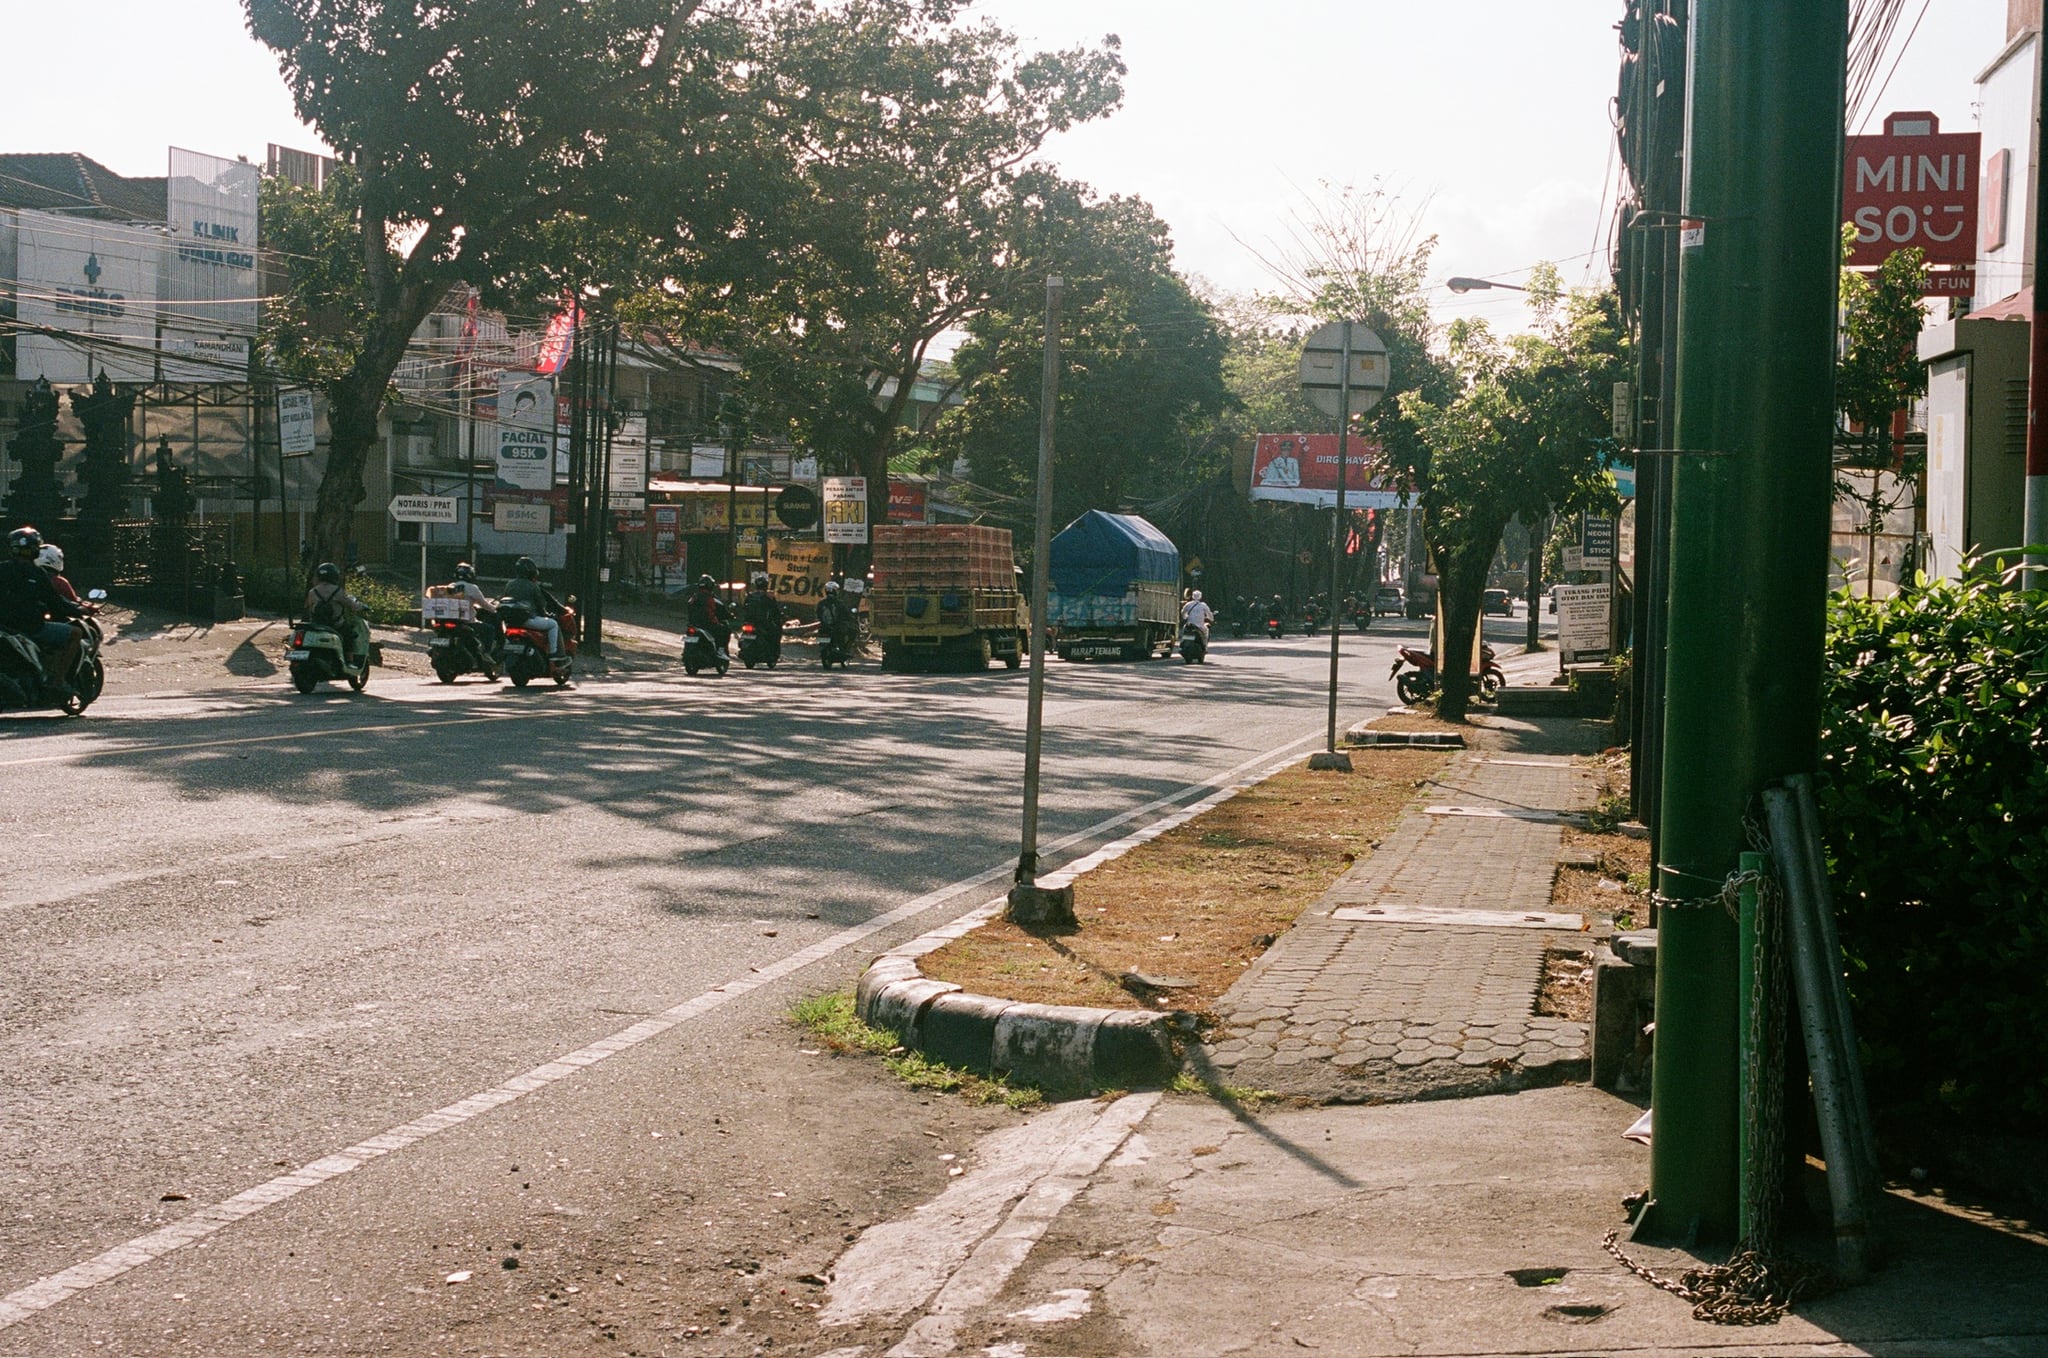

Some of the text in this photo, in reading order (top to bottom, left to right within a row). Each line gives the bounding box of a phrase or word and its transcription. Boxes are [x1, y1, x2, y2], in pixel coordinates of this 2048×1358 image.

[1856, 155, 1966, 193] MINI
[193, 221, 239, 243] KLINIK
[1938, 278, 1970, 290] FUN
[502, 431, 547, 444] FACIAL
[512, 448, 537, 458] 95K
[1316, 455, 1370, 464] DIRGHAYU
[398, 500, 428, 508] NOTARIS
[434, 501, 451, 509] PPAT
[826, 500, 866, 524] AKI
[770, 550, 798, 561] Frame
[808, 554, 828, 563] Lens
[787, 563, 810, 572] Start
[1070, 647, 1094, 656] HARAP
